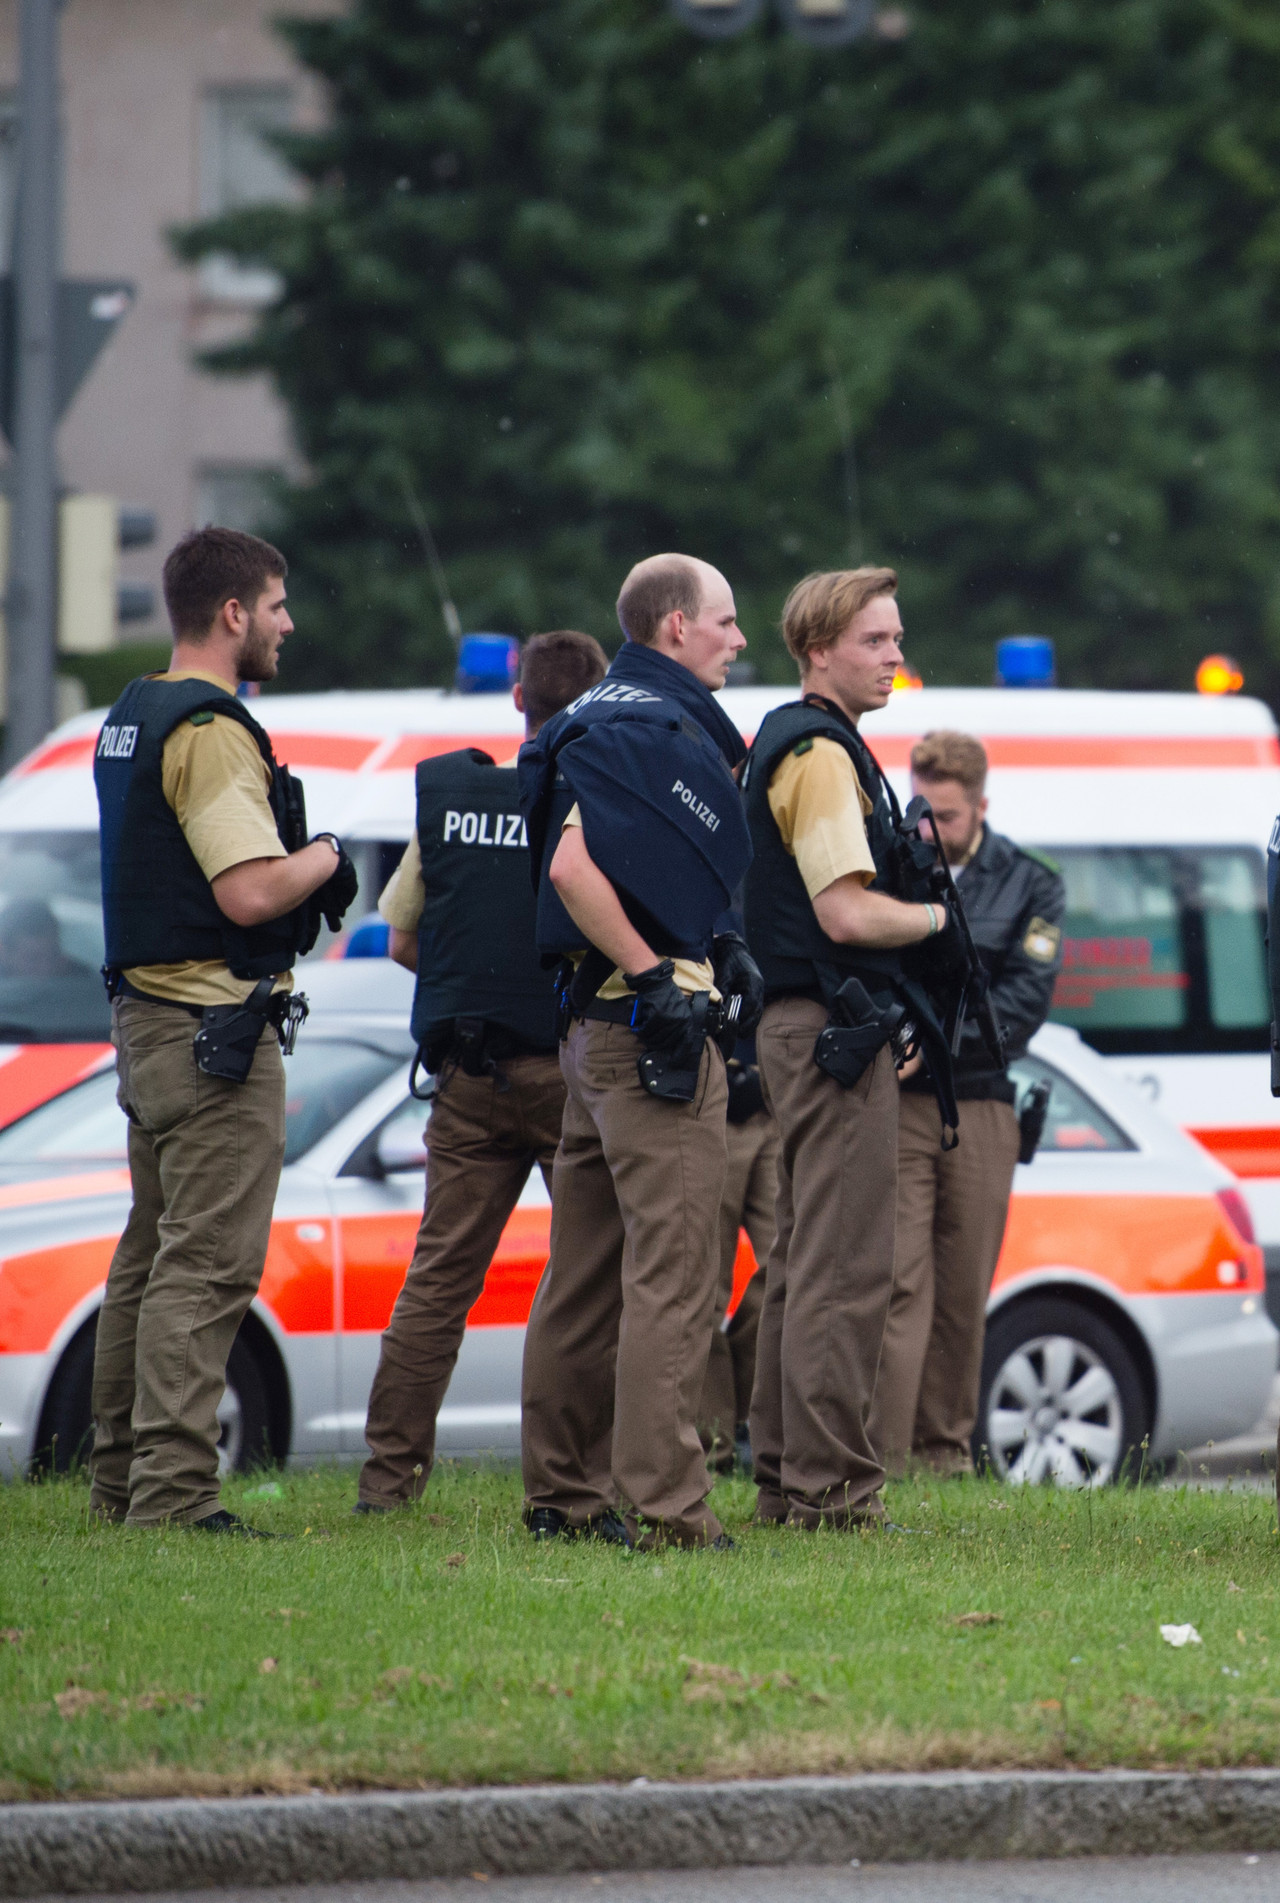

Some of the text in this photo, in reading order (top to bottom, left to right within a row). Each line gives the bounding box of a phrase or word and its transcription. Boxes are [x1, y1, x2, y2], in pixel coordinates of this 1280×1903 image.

[563, 683, 663, 715] OLIZEI
[97, 725, 138, 757] POLIZEI
[671, 779, 721, 832] POLIZEI
